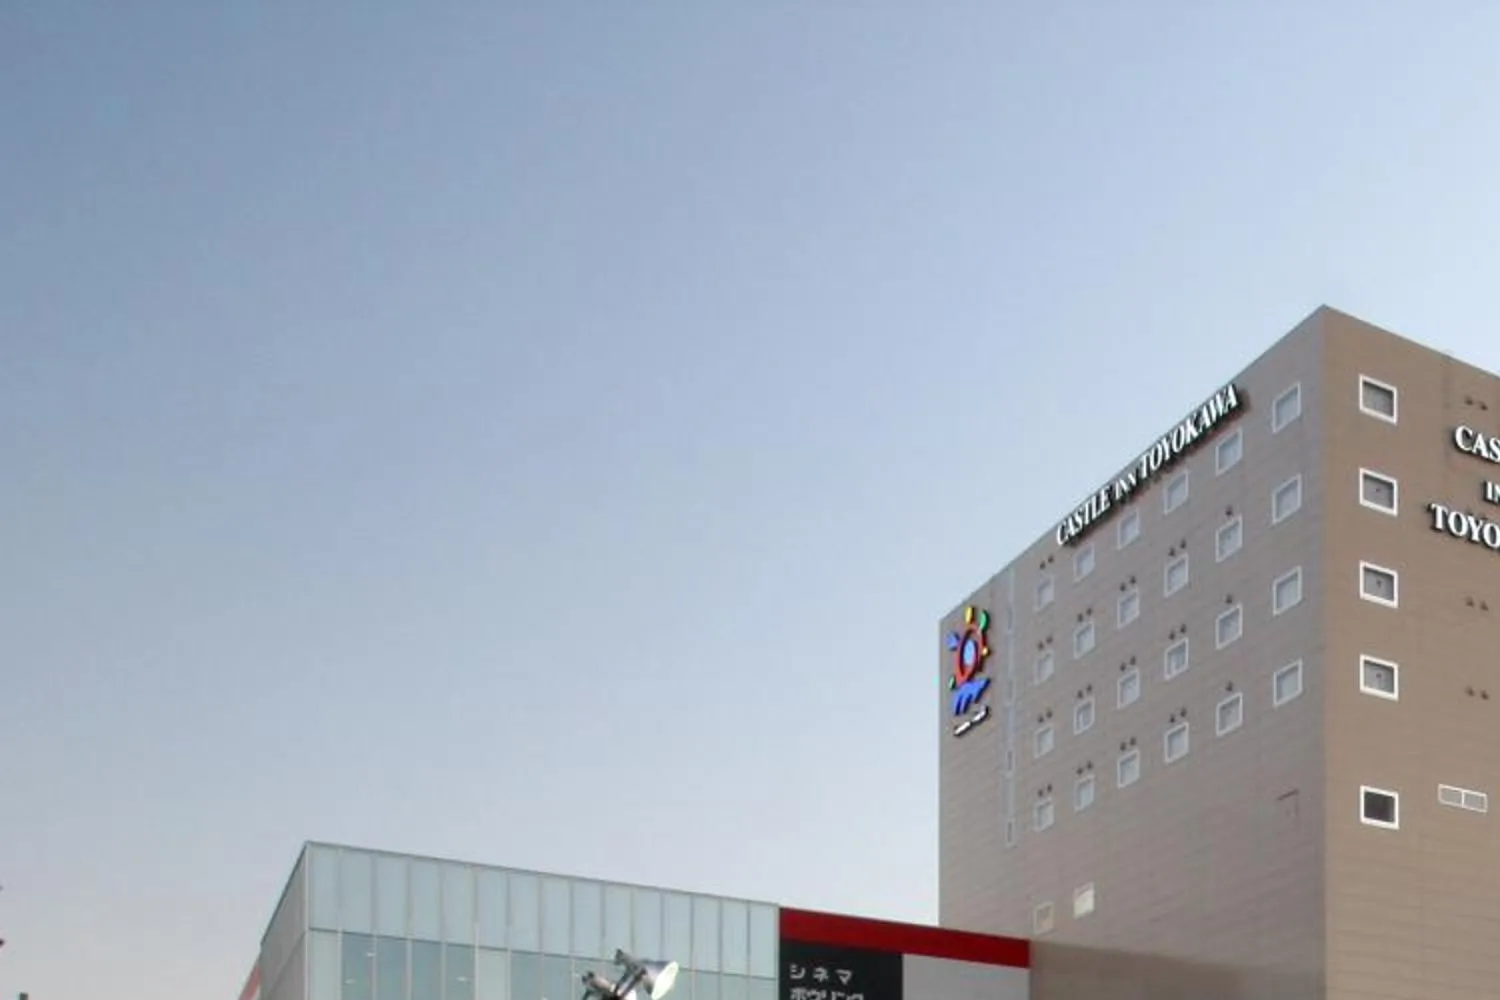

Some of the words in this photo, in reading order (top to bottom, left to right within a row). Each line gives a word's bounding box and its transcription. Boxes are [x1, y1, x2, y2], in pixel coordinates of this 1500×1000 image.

[1056, 487, 1111, 545] CASTLE
[1114, 470, 1137, 501] INN
[1141, 383, 1238, 479] TOYOKAWA
[790, 963, 853, 984] シネマ
